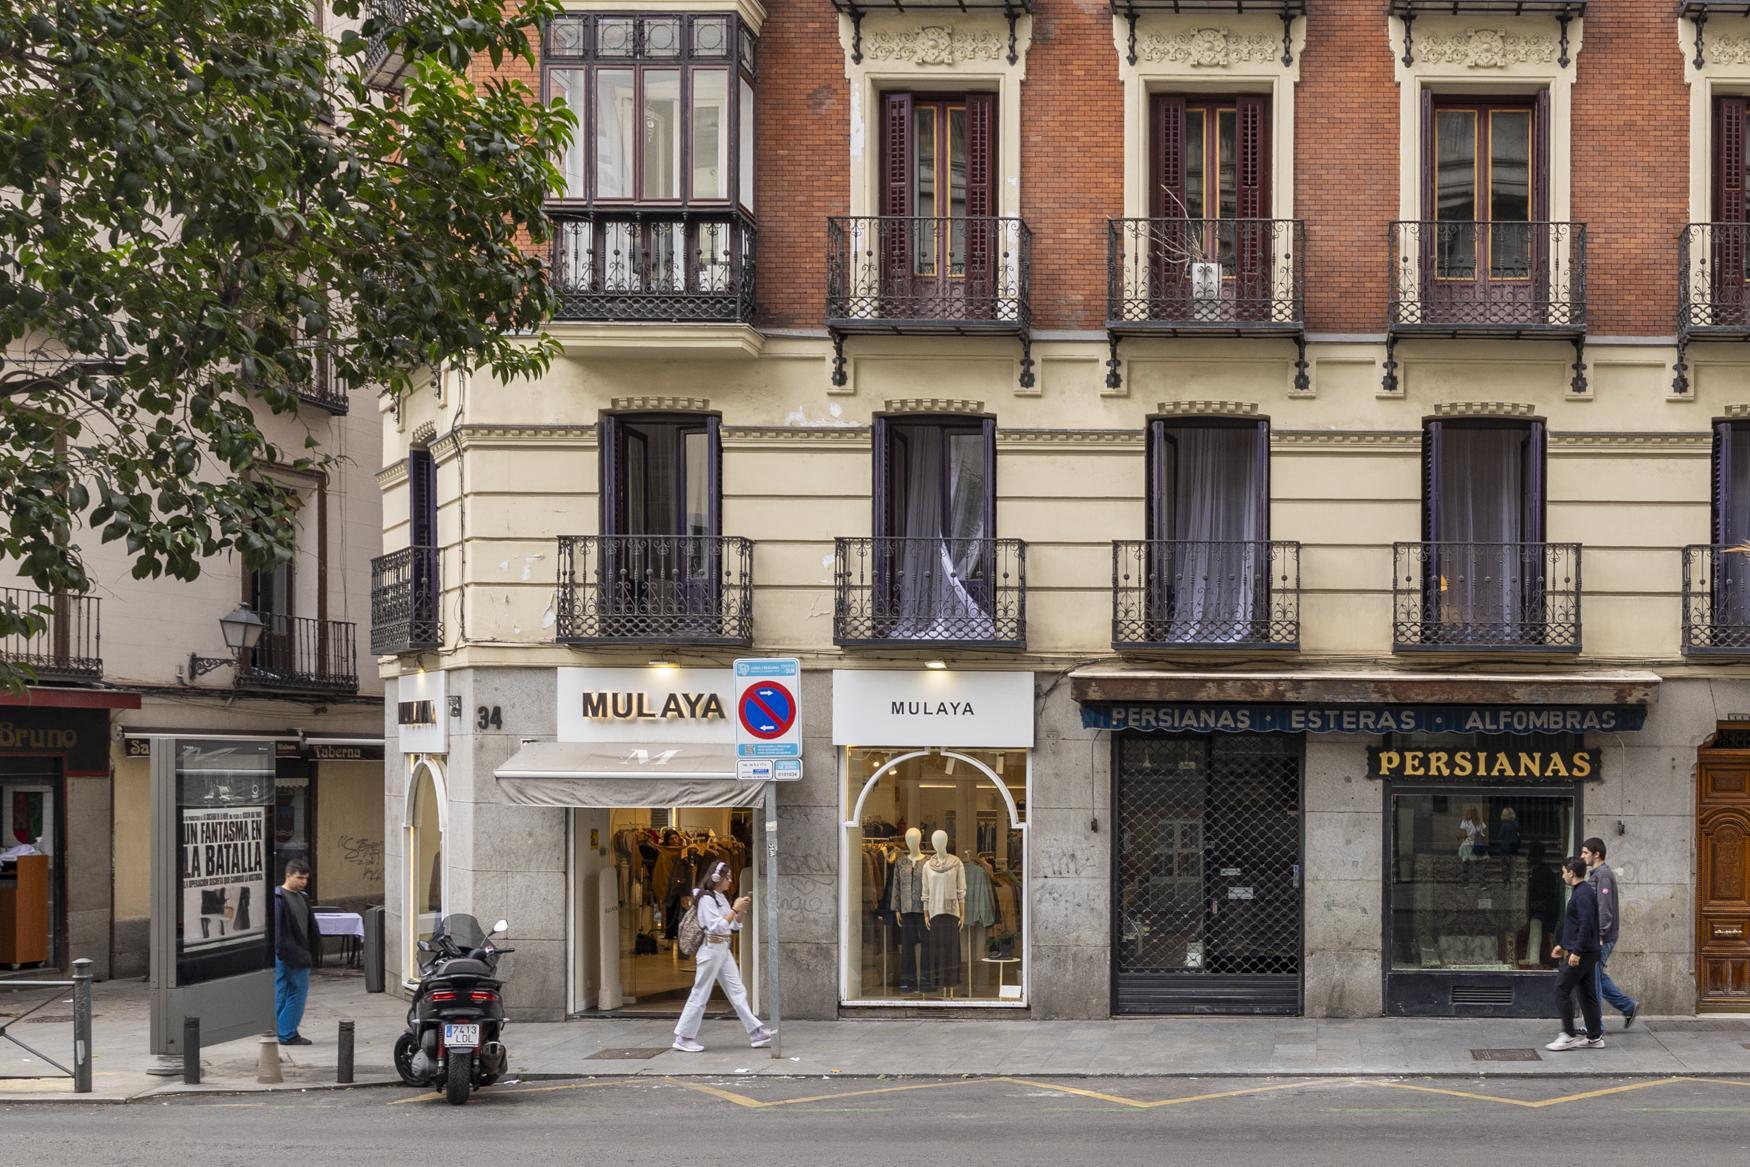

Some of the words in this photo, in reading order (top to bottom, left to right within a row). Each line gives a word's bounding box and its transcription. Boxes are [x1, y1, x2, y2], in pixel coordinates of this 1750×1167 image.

[582, 692, 726, 719] MULAYA
[891, 701, 975, 715] MULAYA
[478, 706, 502, 730] 34
[1112, 707, 1250, 728] PERSIANAS
[1291, 709, 1416, 730] ESTERAS
[1465, 710, 1617, 730] ALFOMBRAS
[0, 722, 77, 748] Bruno
[313, 745, 361, 758] Taberna
[1379, 751, 1592, 776] PERSIANAS
[184, 822, 198, 844] UN
[201, 821, 249, 843] FANTASMA
[252, 819, 262, 841] EN
[184, 845, 201, 879] LA
[206, 842, 262, 876] BATALLA
[453, 1026, 477, 1035] 7413
